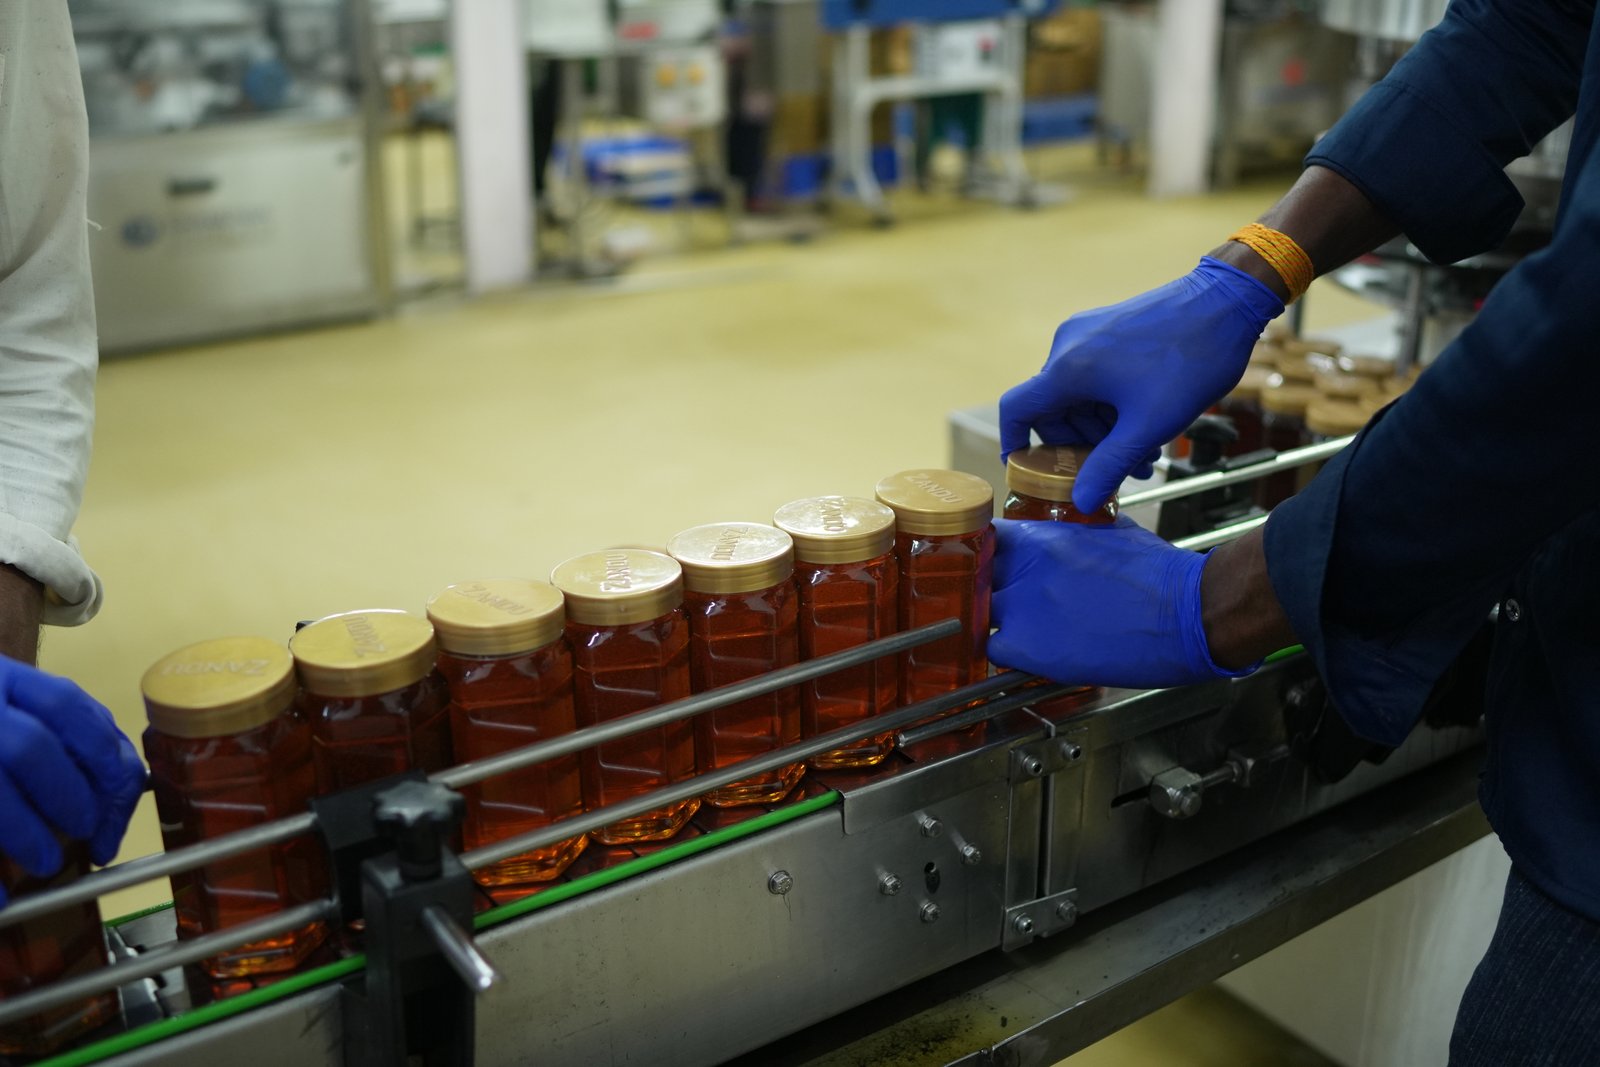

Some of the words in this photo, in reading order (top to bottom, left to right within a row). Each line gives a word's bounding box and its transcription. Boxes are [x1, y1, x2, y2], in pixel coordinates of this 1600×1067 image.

[903, 472, 963, 504] ZANDU
[819, 498, 847, 532] ZANDU
[710, 527, 749, 561] ZANDU
[599, 553, 632, 592] ZANDU
[455, 584, 534, 616] ZANDU
[341, 614, 387, 659] ZANDU
[160, 658, 271, 677] ZANDU
